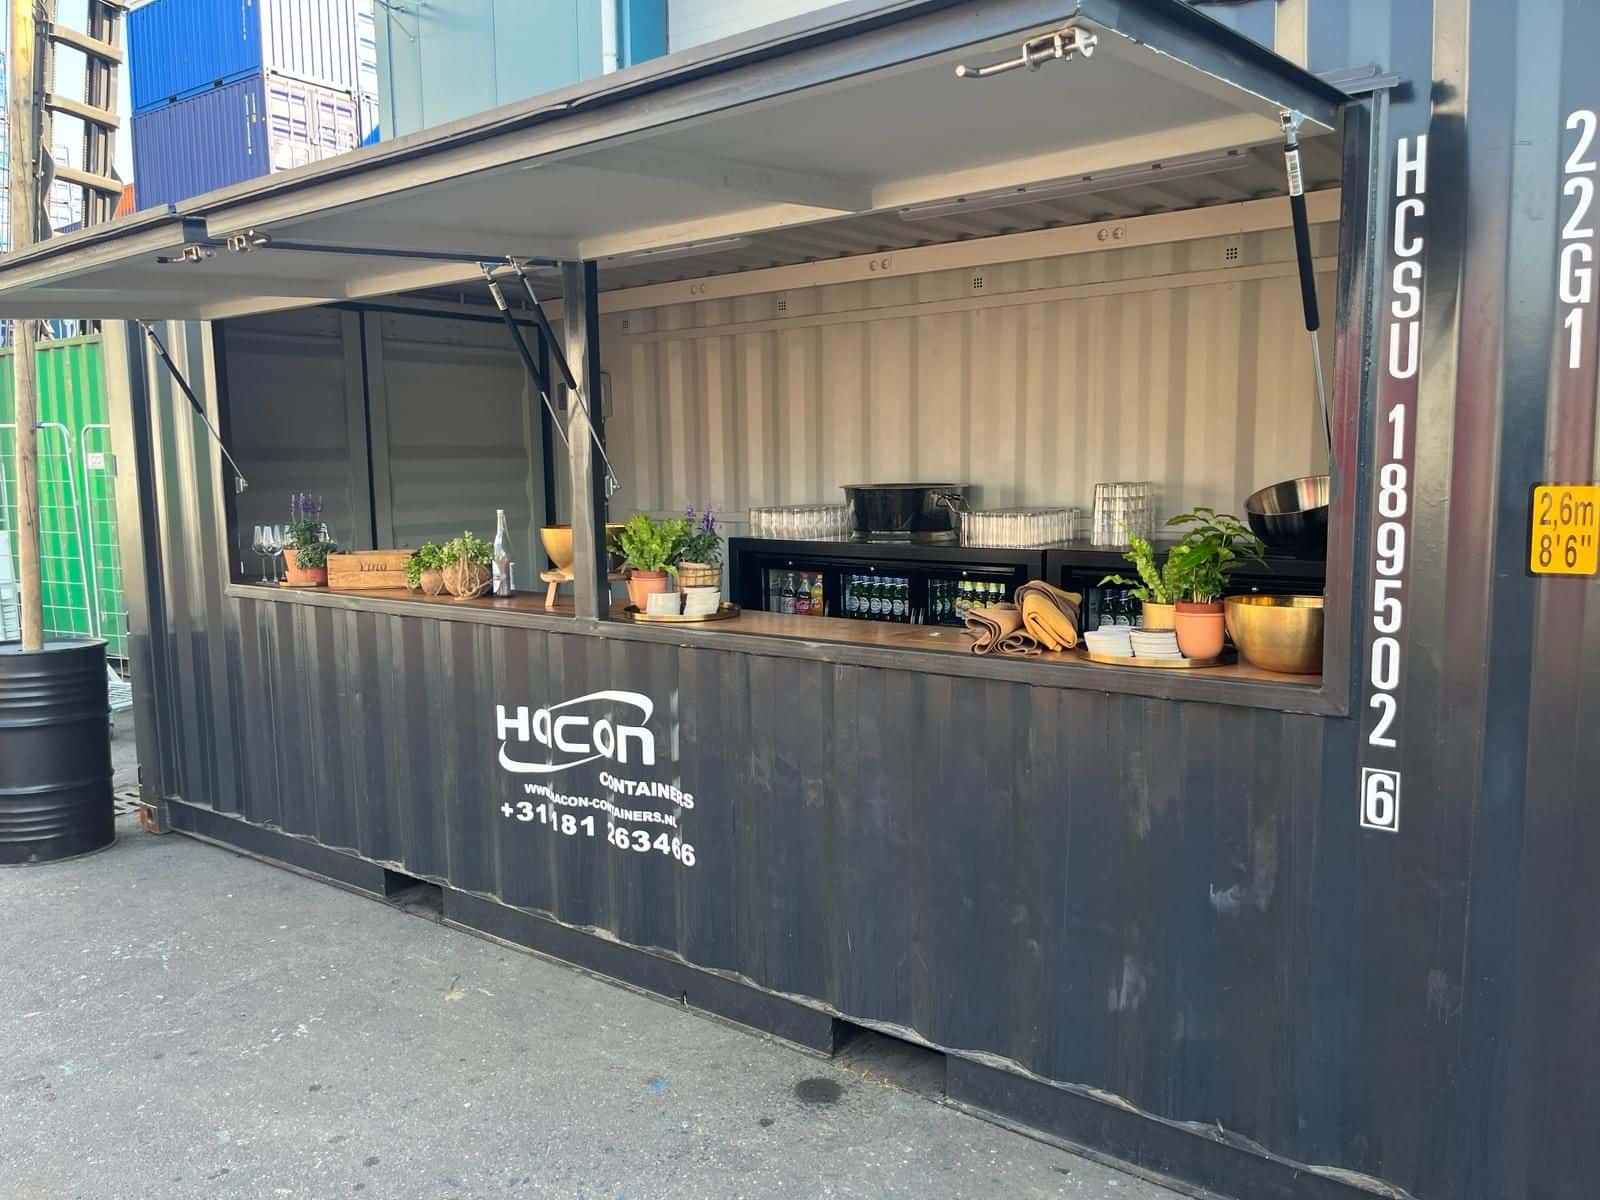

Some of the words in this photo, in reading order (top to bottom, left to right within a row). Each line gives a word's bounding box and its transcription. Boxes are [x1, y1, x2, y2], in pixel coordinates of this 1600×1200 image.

[1388, 134, 1427, 379] HCSU
[1559, 109, 1598, 369] 22G1
[1539, 492, 1594, 531] 2,6m
[1368, 403, 1408, 748] 189502
[599, 771, 694, 809] CONTAINERS
[1365, 771, 1396, 826] 6
[500, 801, 547, 825] +31
[551, 811, 596, 837] 181
[607, 822, 696, 867] 263466
